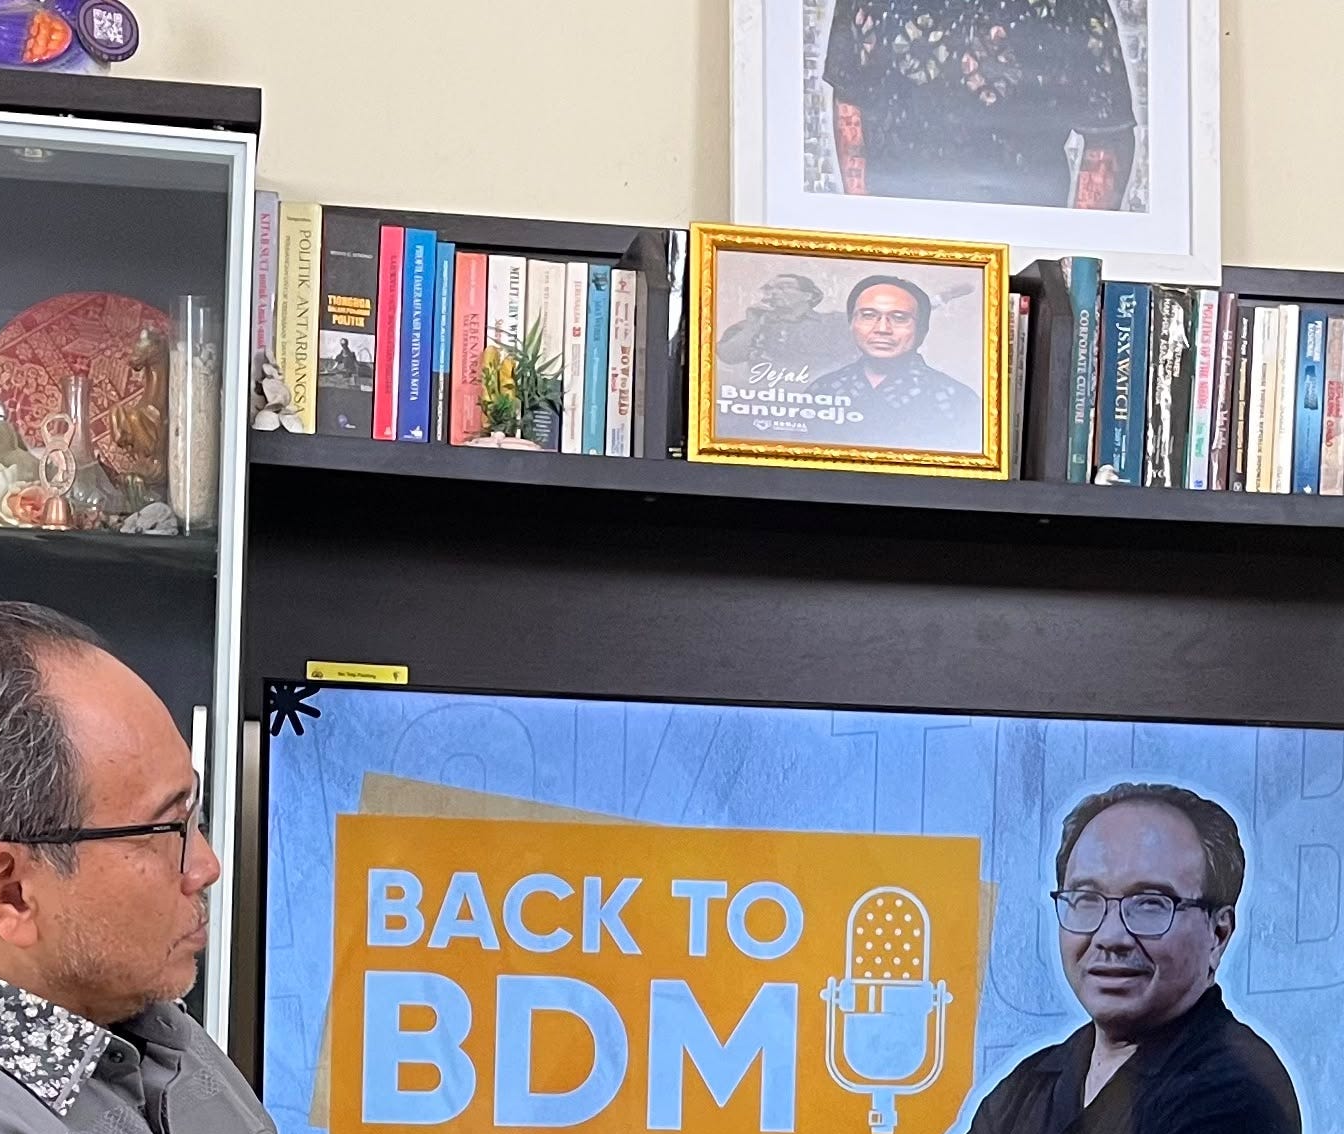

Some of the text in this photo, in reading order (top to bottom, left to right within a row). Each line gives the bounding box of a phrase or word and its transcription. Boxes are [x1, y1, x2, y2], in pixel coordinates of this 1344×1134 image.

[508, 266, 521, 319] MILITARY
[294, 229, 313, 415] POLITIK ANTARBANGSA
[1201, 303, 1213, 344] POLITICS
[469, 313, 481, 386] KEBENARAN
[620, 345, 631, 377] HOW
[1074, 309, 1089, 425] CORPORATE CULTURE
[1199, 361, 1211, 379] THE
[1200, 346, 1212, 360] OF
[749, 361, 810, 388] Jejak
[1115, 322, 1131, 420] JSX WATCH
[618, 389, 629, 416] READ
[716, 399, 864, 425] Tanuredjo
[721, 384, 852, 407] Budiman
[367, 868, 805, 960] BACK TO
[361, 970, 799, 1134] BDM
